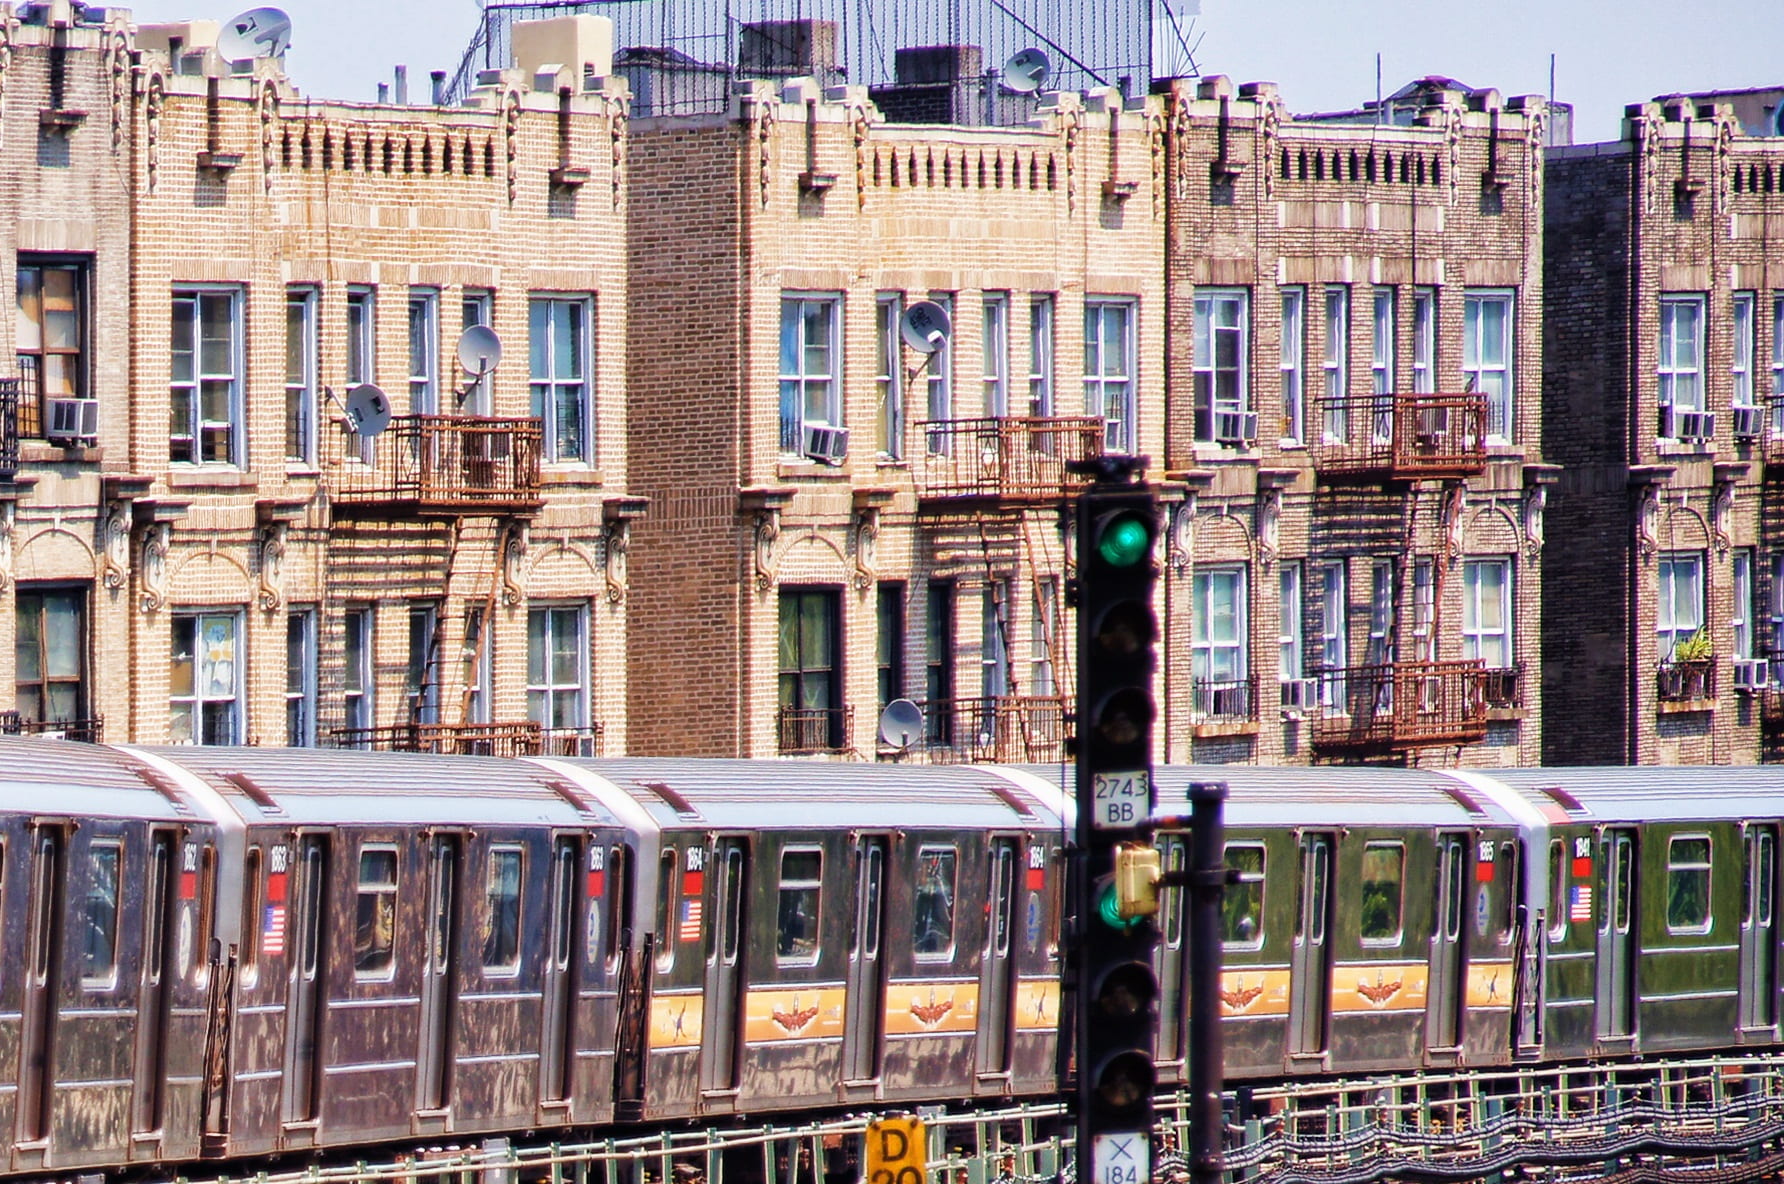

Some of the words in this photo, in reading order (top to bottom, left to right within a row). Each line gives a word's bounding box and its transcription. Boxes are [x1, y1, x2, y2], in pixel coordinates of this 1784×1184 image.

[1096, 778, 1148, 799] 2743
[1108, 803, 1134, 823] BB
[881, 1128, 909, 1162] D
[1109, 1138, 1134, 1160] X
